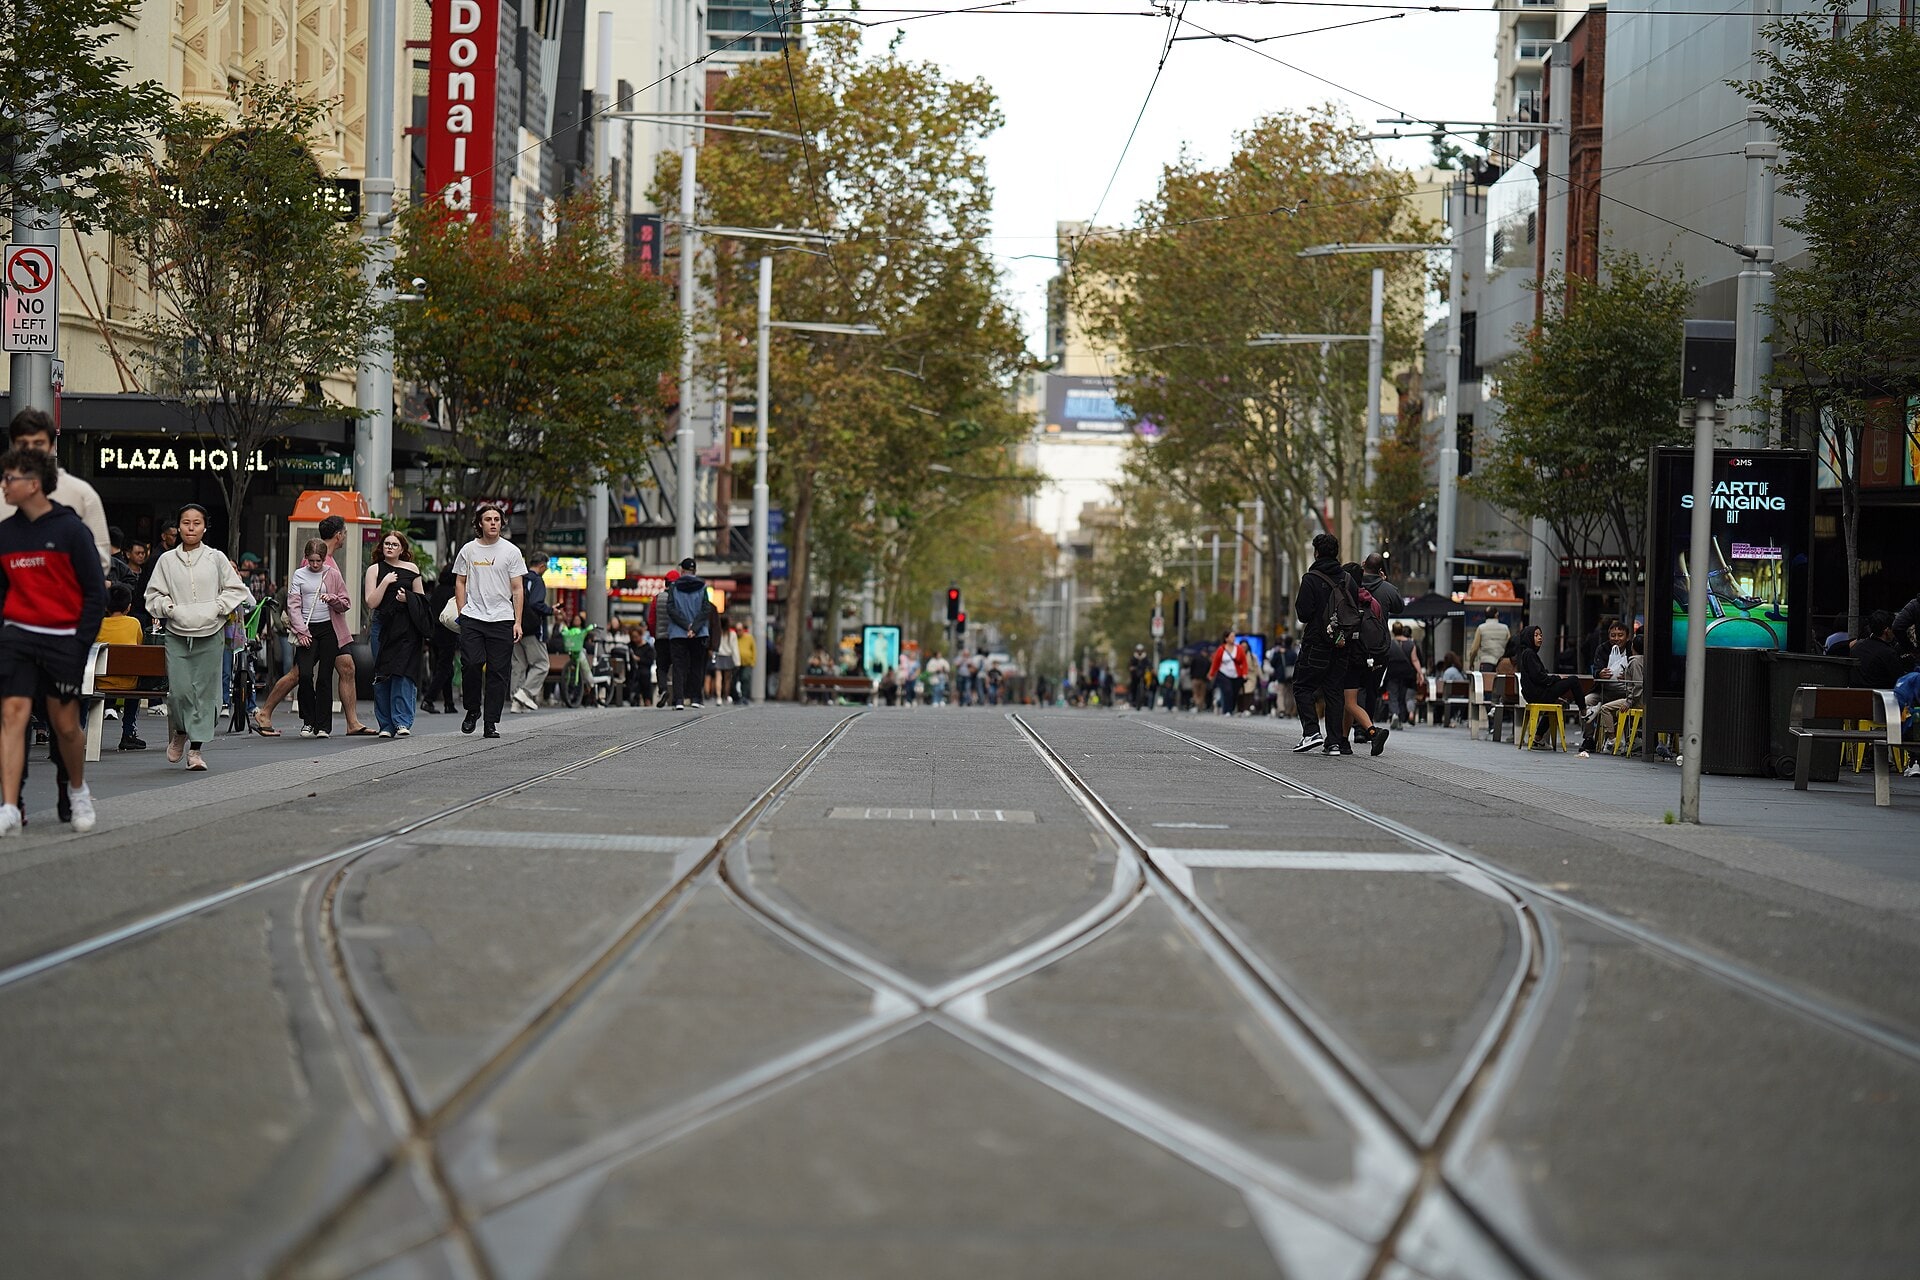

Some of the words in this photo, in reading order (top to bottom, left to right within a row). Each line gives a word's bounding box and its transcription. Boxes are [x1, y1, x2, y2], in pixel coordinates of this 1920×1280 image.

[17, 298, 45, 314] NO
[13, 318, 46, 330] LEFT
[12, 333, 48, 345] TURN
[100, 448, 179, 470] PLAZA
[1759, 481, 1769, 496] OF
[1681, 494, 1786, 511] SINGING
[1726, 510, 1740, 524] BIT
